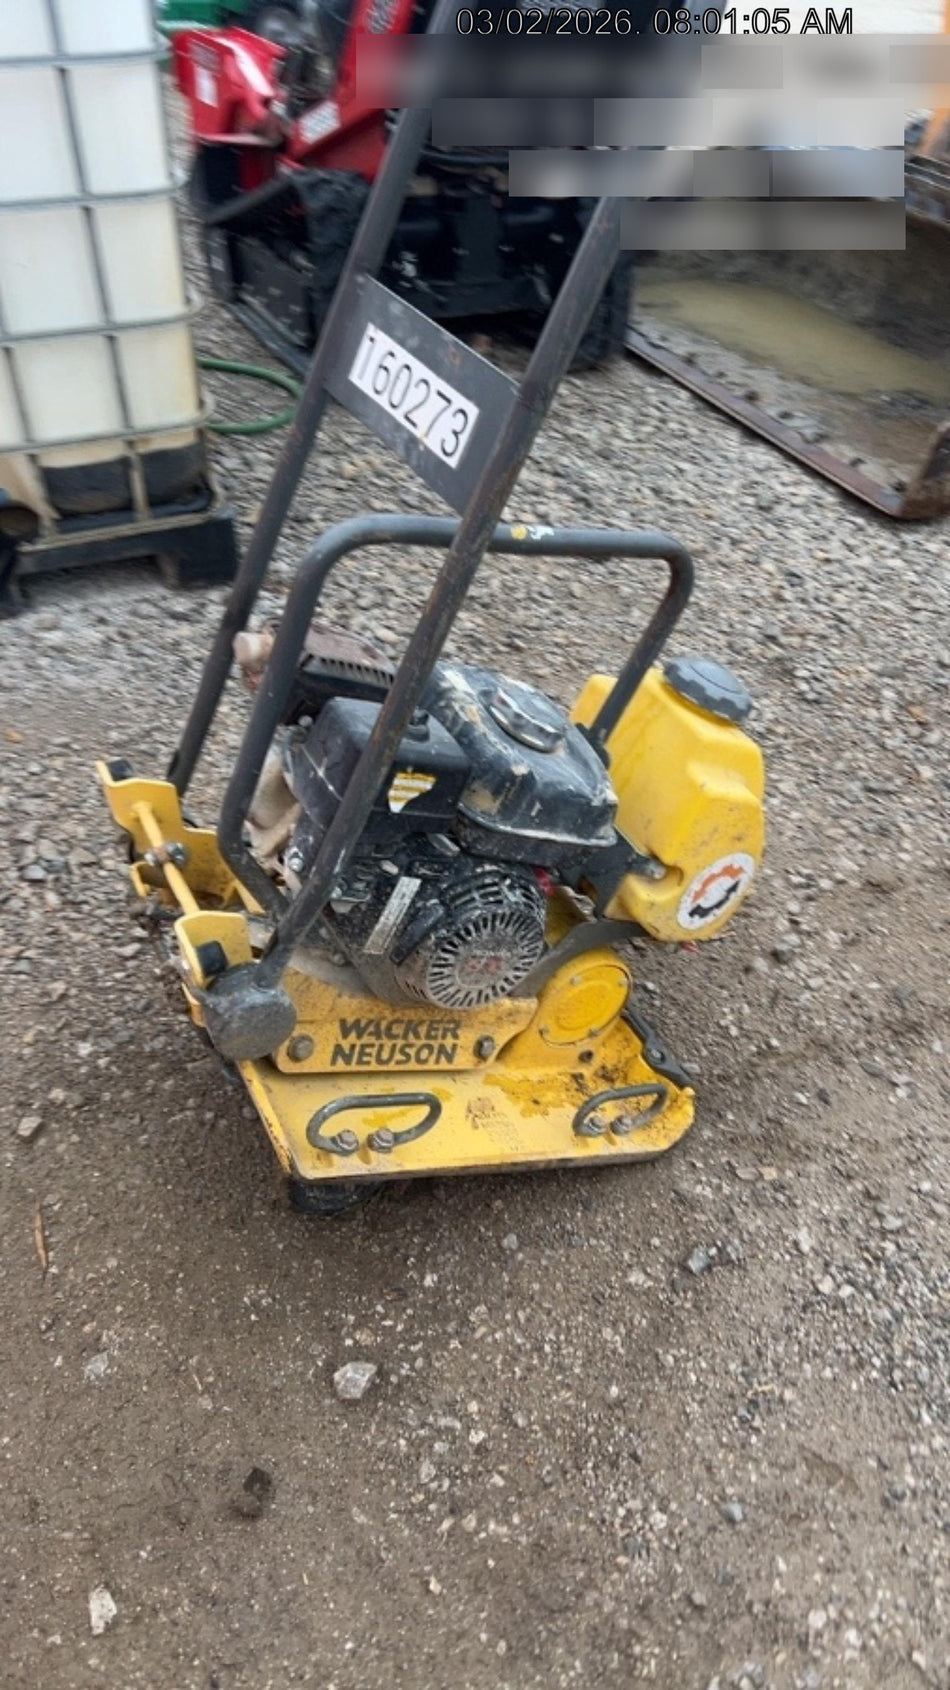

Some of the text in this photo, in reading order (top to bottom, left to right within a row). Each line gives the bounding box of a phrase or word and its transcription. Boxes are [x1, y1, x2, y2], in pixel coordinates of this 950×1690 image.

[359, 335, 469, 458] 160273
[339, 1018, 460, 1041] WACKER
[330, 1043, 458, 1066] NEUSON
